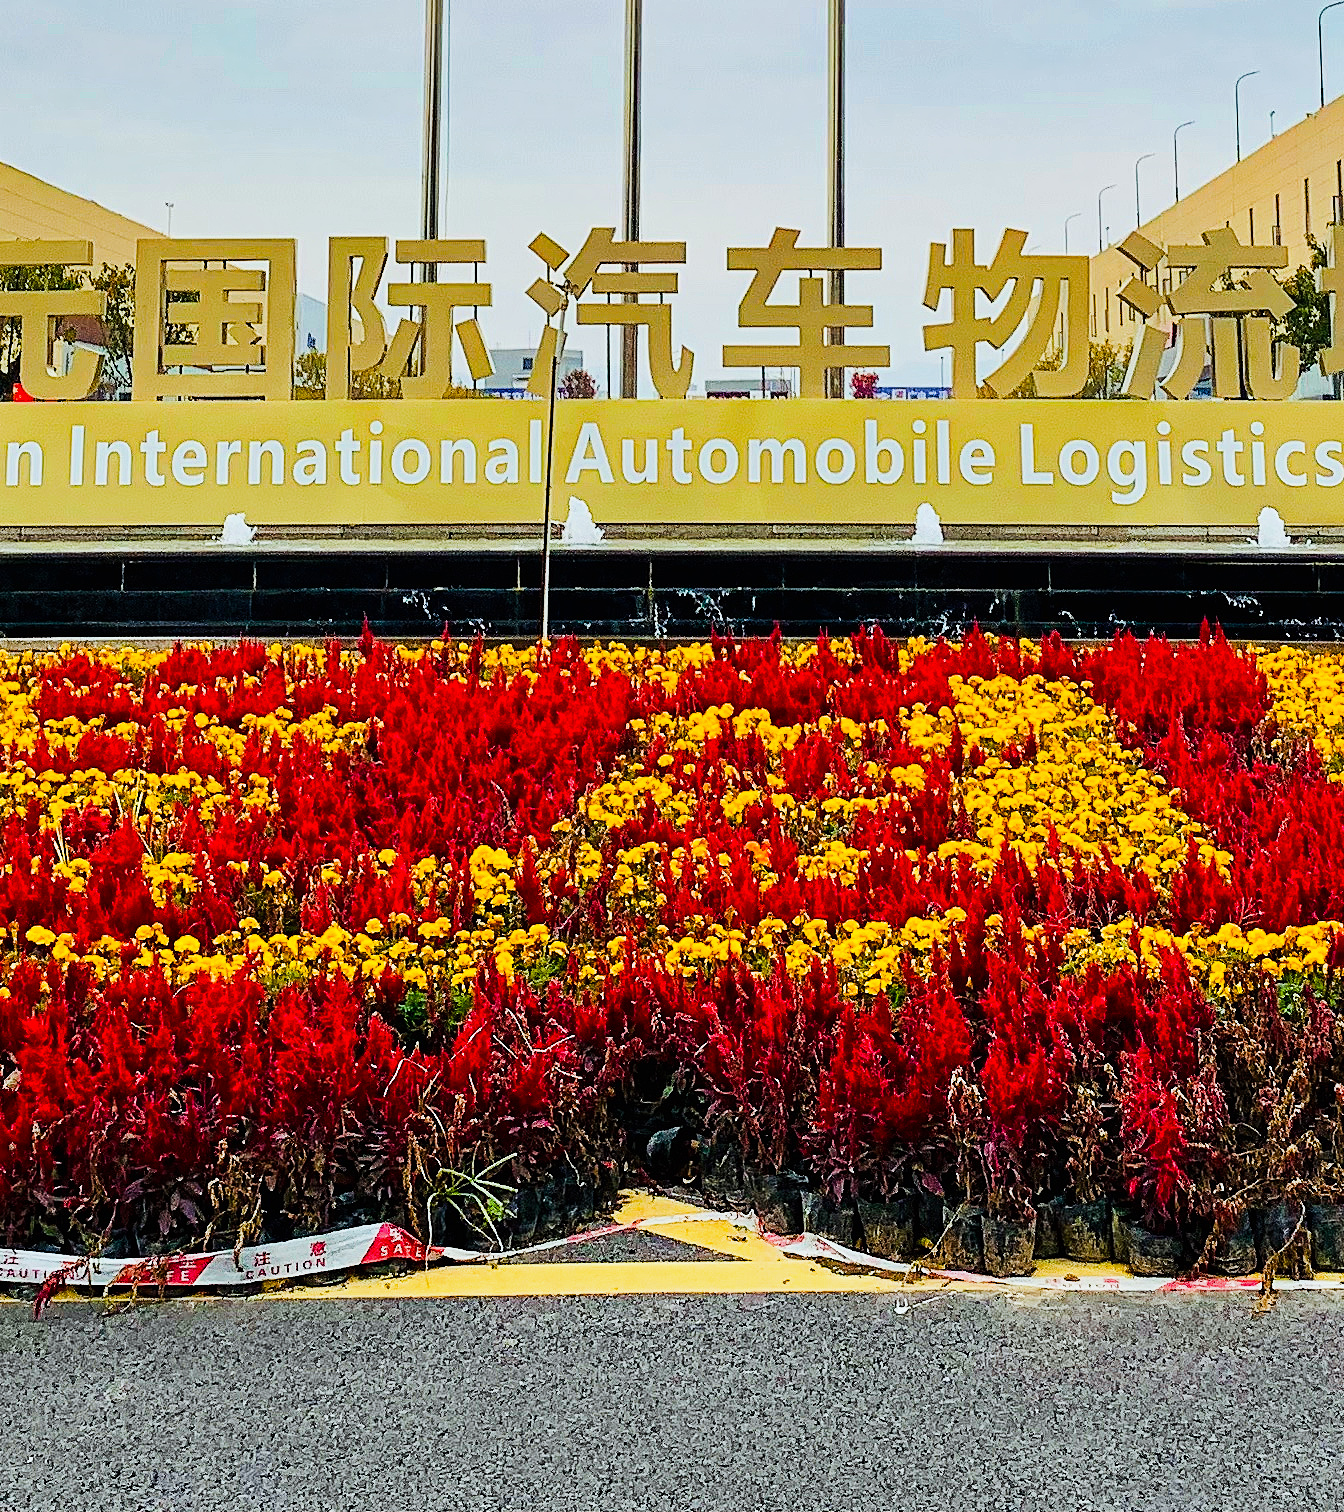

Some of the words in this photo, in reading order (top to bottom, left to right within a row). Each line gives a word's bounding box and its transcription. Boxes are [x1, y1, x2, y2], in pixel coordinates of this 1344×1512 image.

[70, 419, 543, 487] International
[565, 419, 997, 485] Automobile
[379, 1244, 424, 1260] SAFE
[245, 1257, 327, 1280] CAUTION
